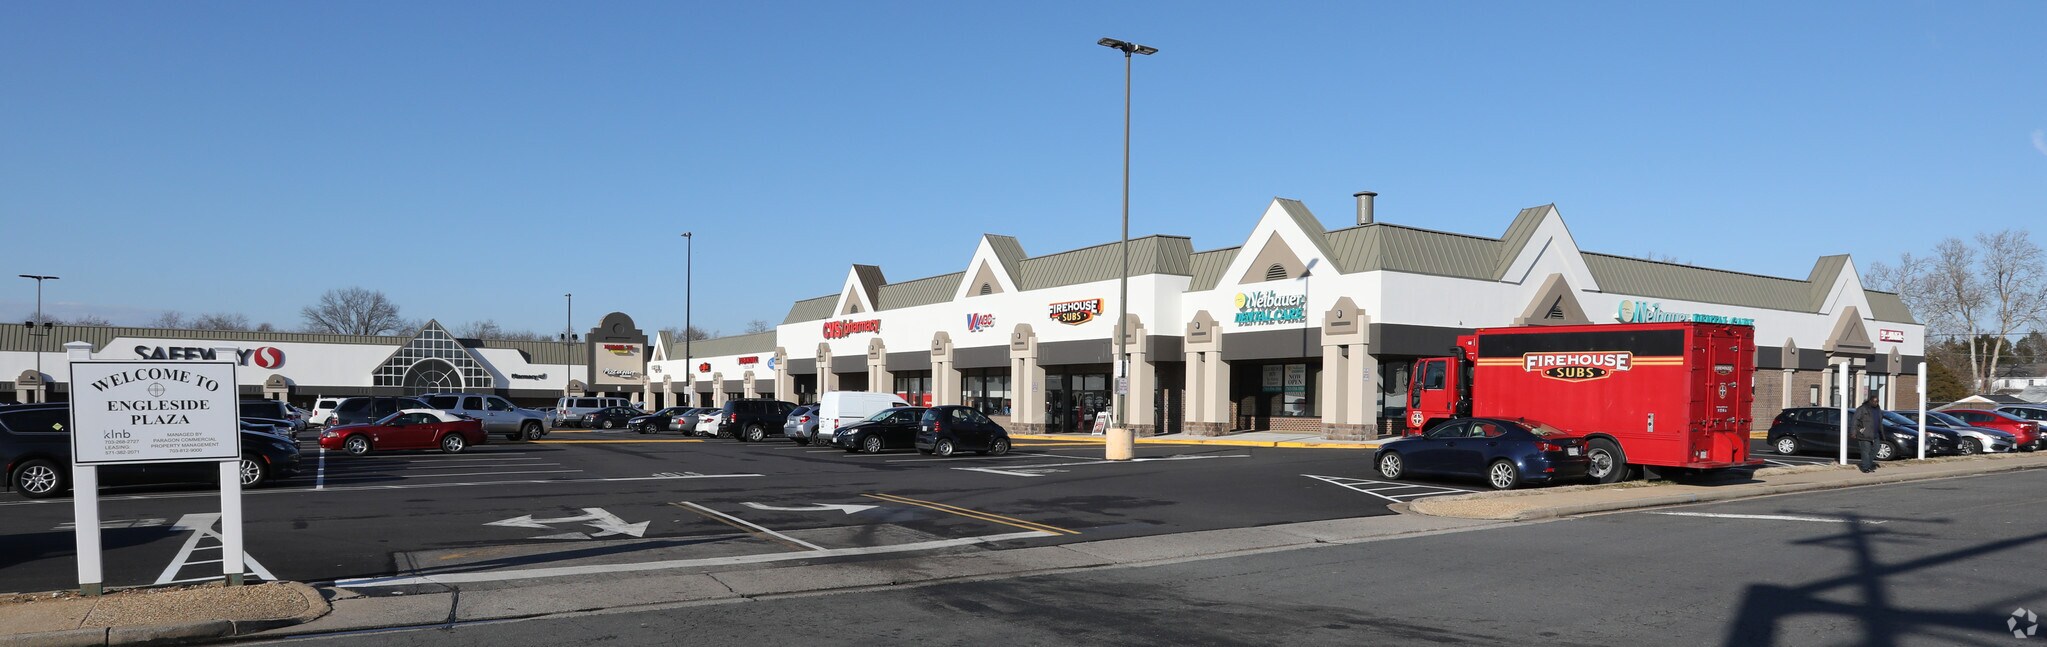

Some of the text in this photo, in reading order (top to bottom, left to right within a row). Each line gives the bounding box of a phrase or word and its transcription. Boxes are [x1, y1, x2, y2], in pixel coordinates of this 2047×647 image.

[1246, 291, 1305, 308] Neibauer
[1049, 300, 1098, 316] FIREHOUSE
[1062, 312, 1081, 321] SUBS
[1235, 308, 1305, 322] DENTAL CARE
[1526, 354, 1629, 372] FIREHOUSE
[1556, 367, 1594, 378] SUBS
[91, 368, 219, 393] WELCOME TO
[107, 400, 210, 412] ENGLESIDE
[131, 414, 190, 425] PLAZA
[103, 429, 131, 439] klnb
